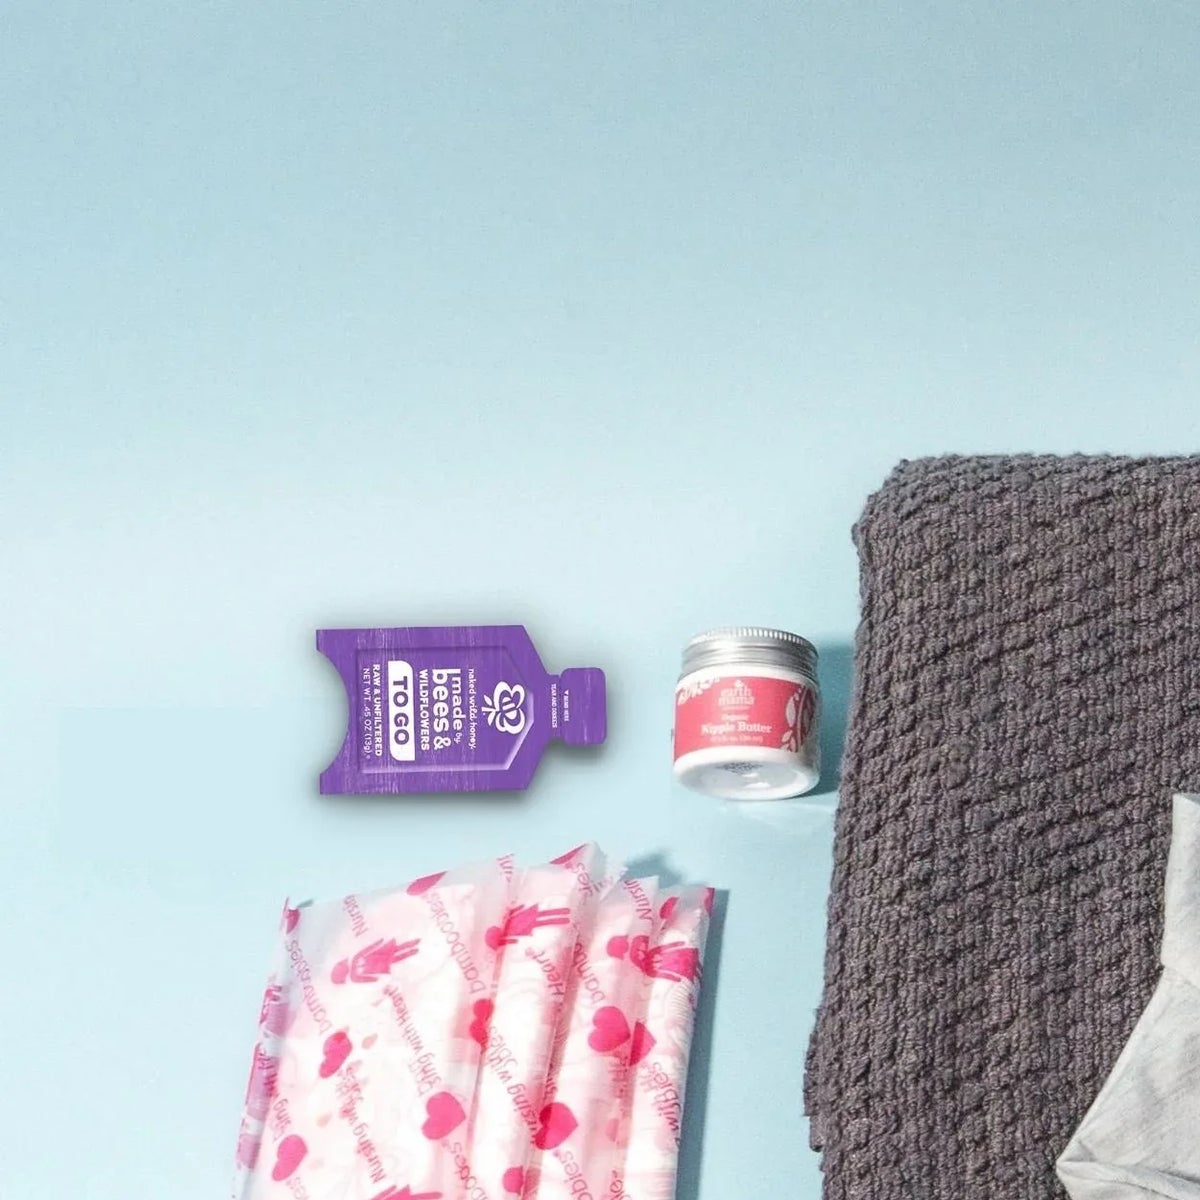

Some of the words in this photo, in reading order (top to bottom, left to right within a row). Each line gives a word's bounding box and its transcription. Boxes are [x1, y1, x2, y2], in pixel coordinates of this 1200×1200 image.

[363, 667, 371, 685] NET
[372, 663, 381, 686] RAW
[468, 668, 477, 695] naked
[392, 675, 409, 708] TO
[432, 668, 461, 733] bees
[452, 676, 466, 731] made
[419, 668, 430, 751] WILDFLOWERS
[468, 695, 478, 721] wild
[373, 697, 383, 757] UNFILTERED
[393, 712, 410, 746] GO
[737, 721, 773, 733] Butter
[433, 735, 452, 750] &
